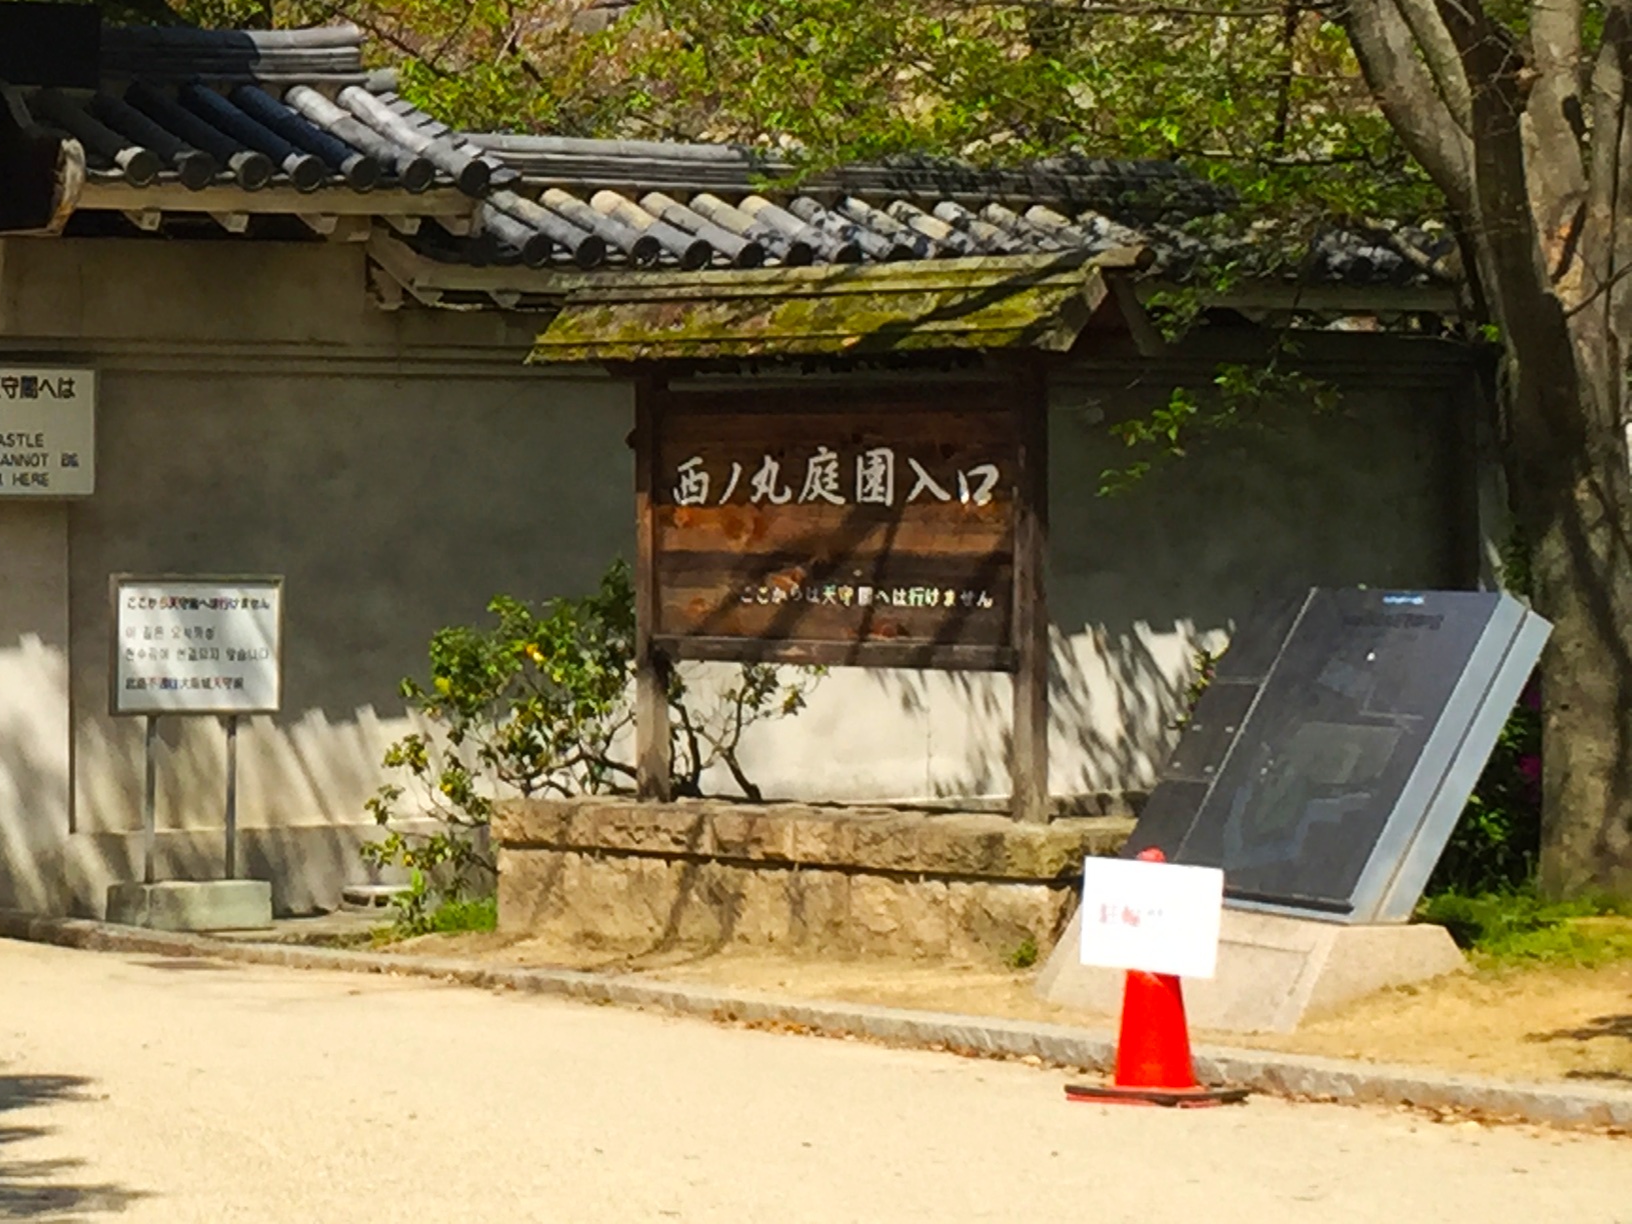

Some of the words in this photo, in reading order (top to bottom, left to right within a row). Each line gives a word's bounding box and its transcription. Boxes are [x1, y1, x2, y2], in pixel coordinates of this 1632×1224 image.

[61, 453, 79, 467] BE
[13, 472, 49, 487] HERE
[671, 445, 1000, 507] 西ノ丸庭園入口
